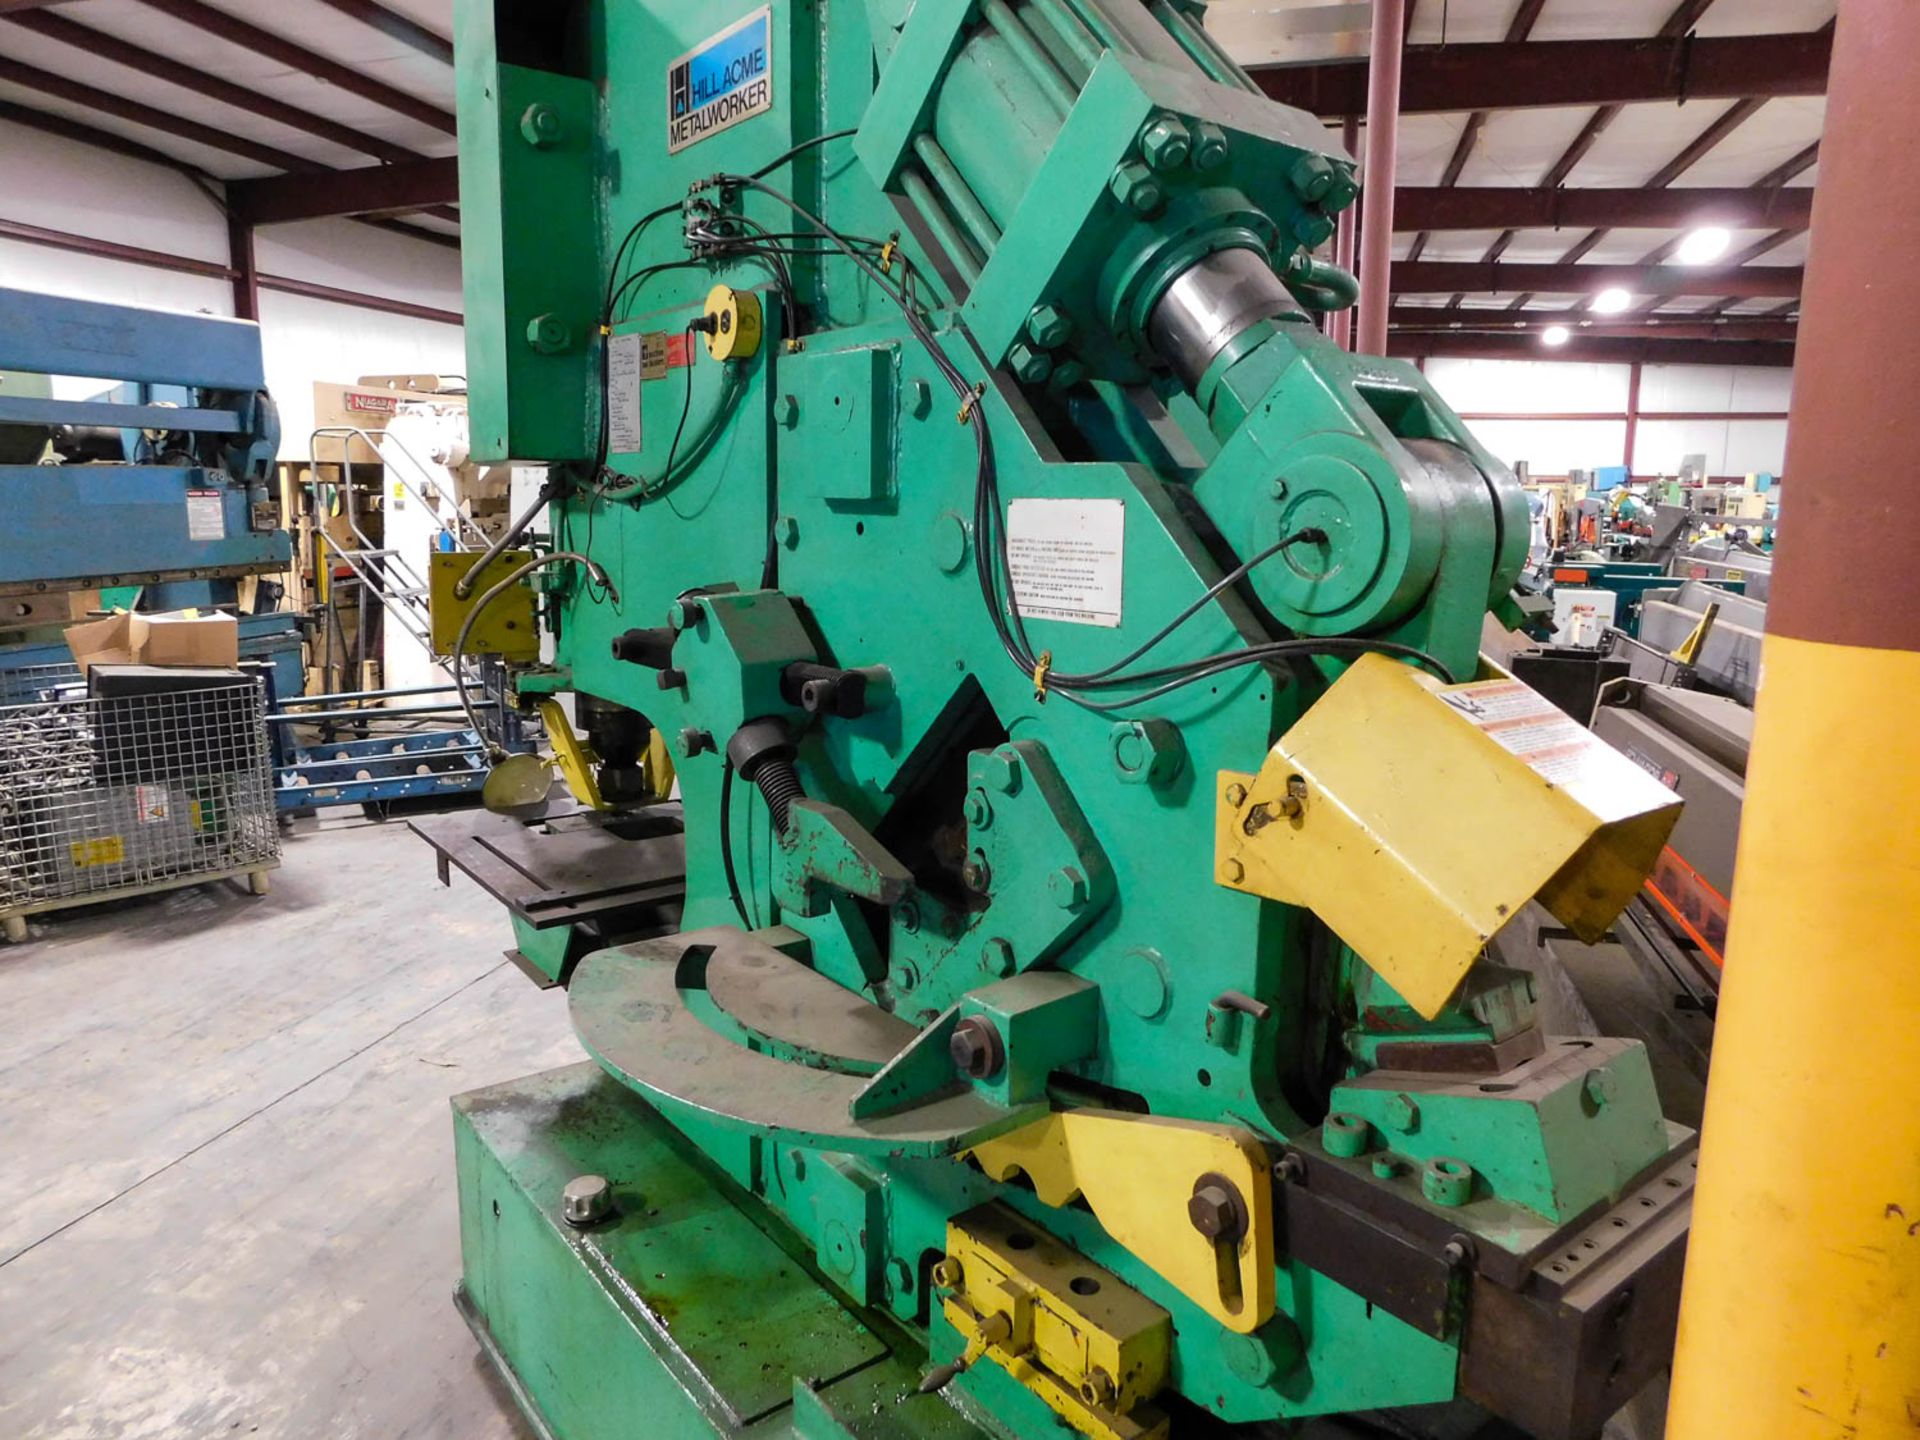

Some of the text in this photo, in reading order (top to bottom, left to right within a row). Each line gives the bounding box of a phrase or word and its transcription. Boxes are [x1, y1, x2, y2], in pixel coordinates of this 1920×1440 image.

[692, 48, 764, 106] HILL ACME
[670, 79, 767, 147] METALWORKER
